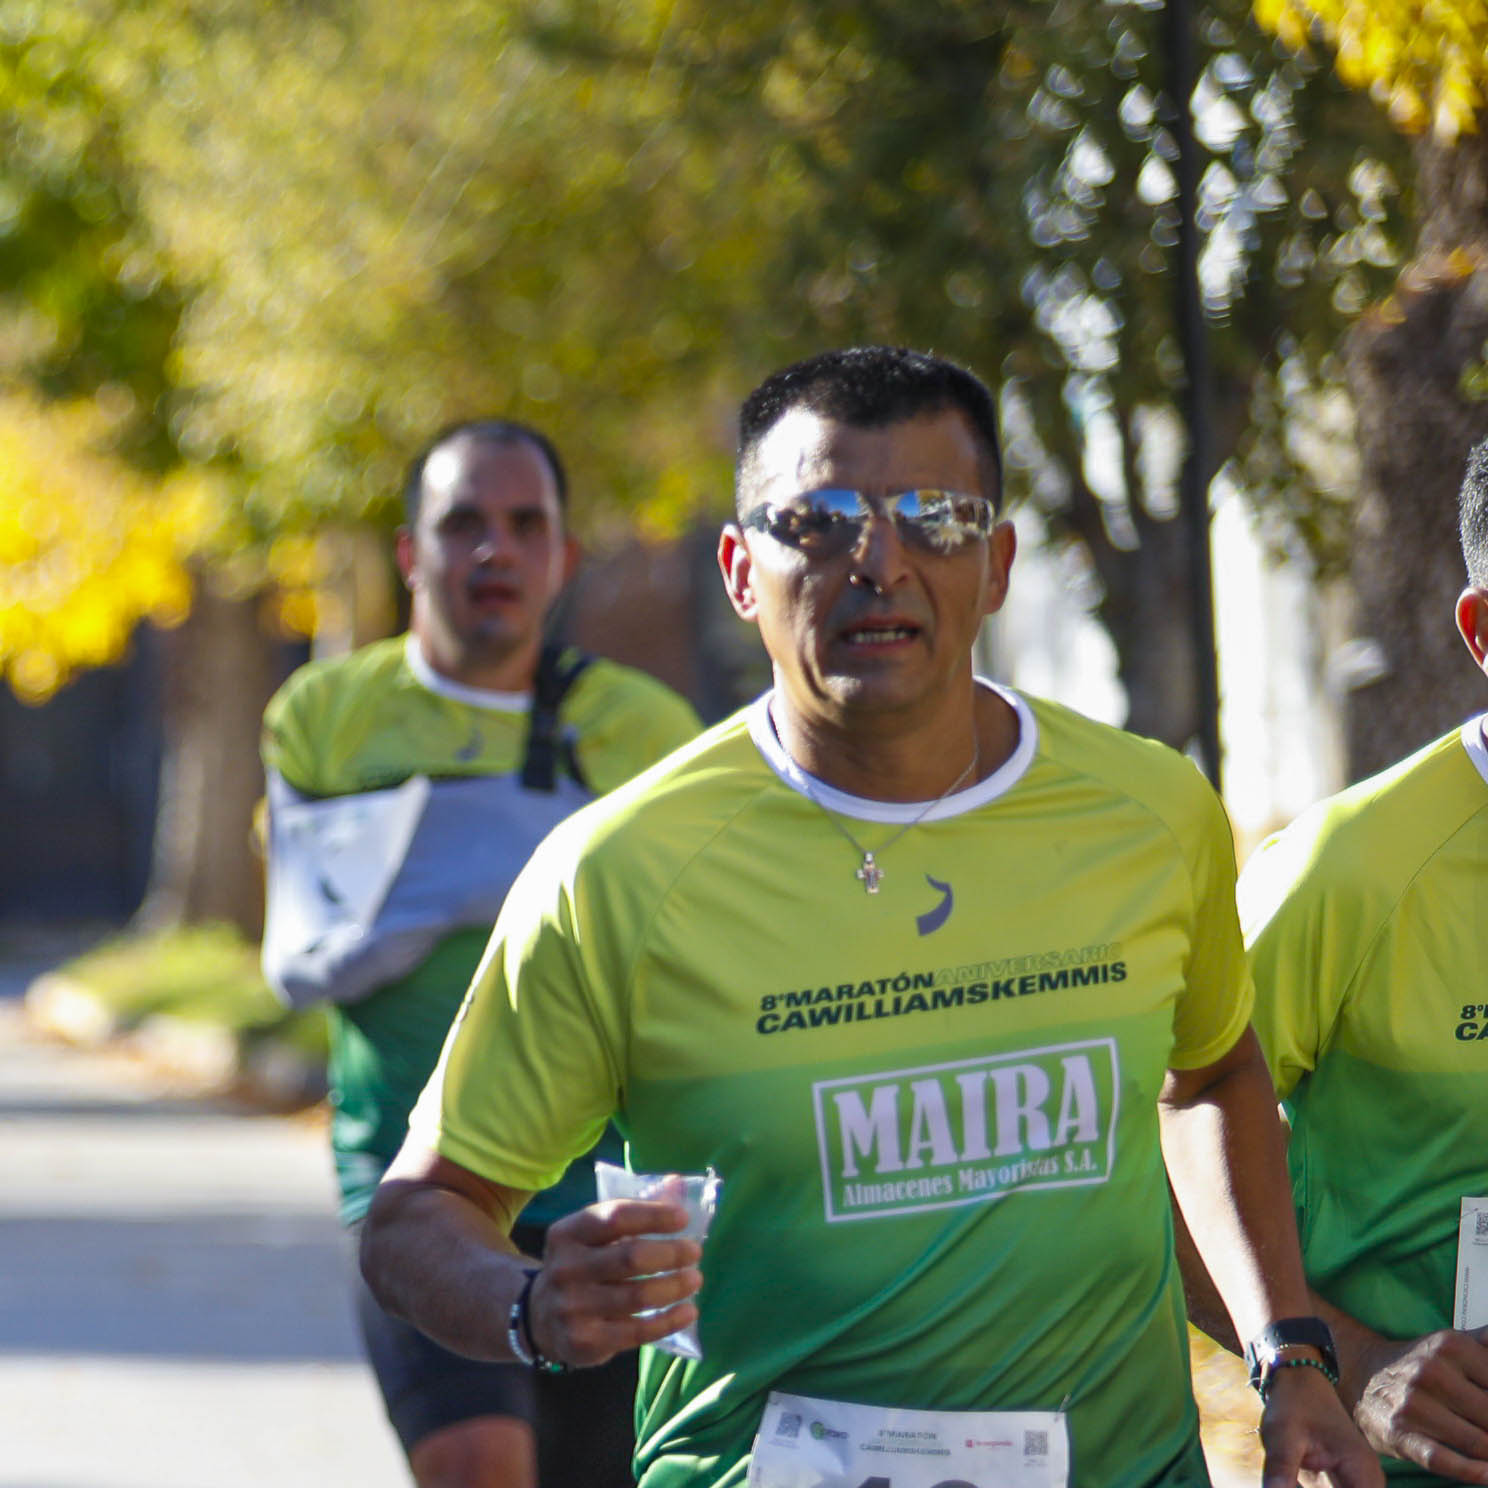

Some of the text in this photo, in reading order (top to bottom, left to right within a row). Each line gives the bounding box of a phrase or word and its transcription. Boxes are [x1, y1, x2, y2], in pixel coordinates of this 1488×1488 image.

[756, 961, 1128, 1035] CAWILLIAMSKEMMIS
[833, 1055, 1100, 1178] MAIRA
[842, 1148, 1098, 1208] Almacenes Mayoristas S.A.
